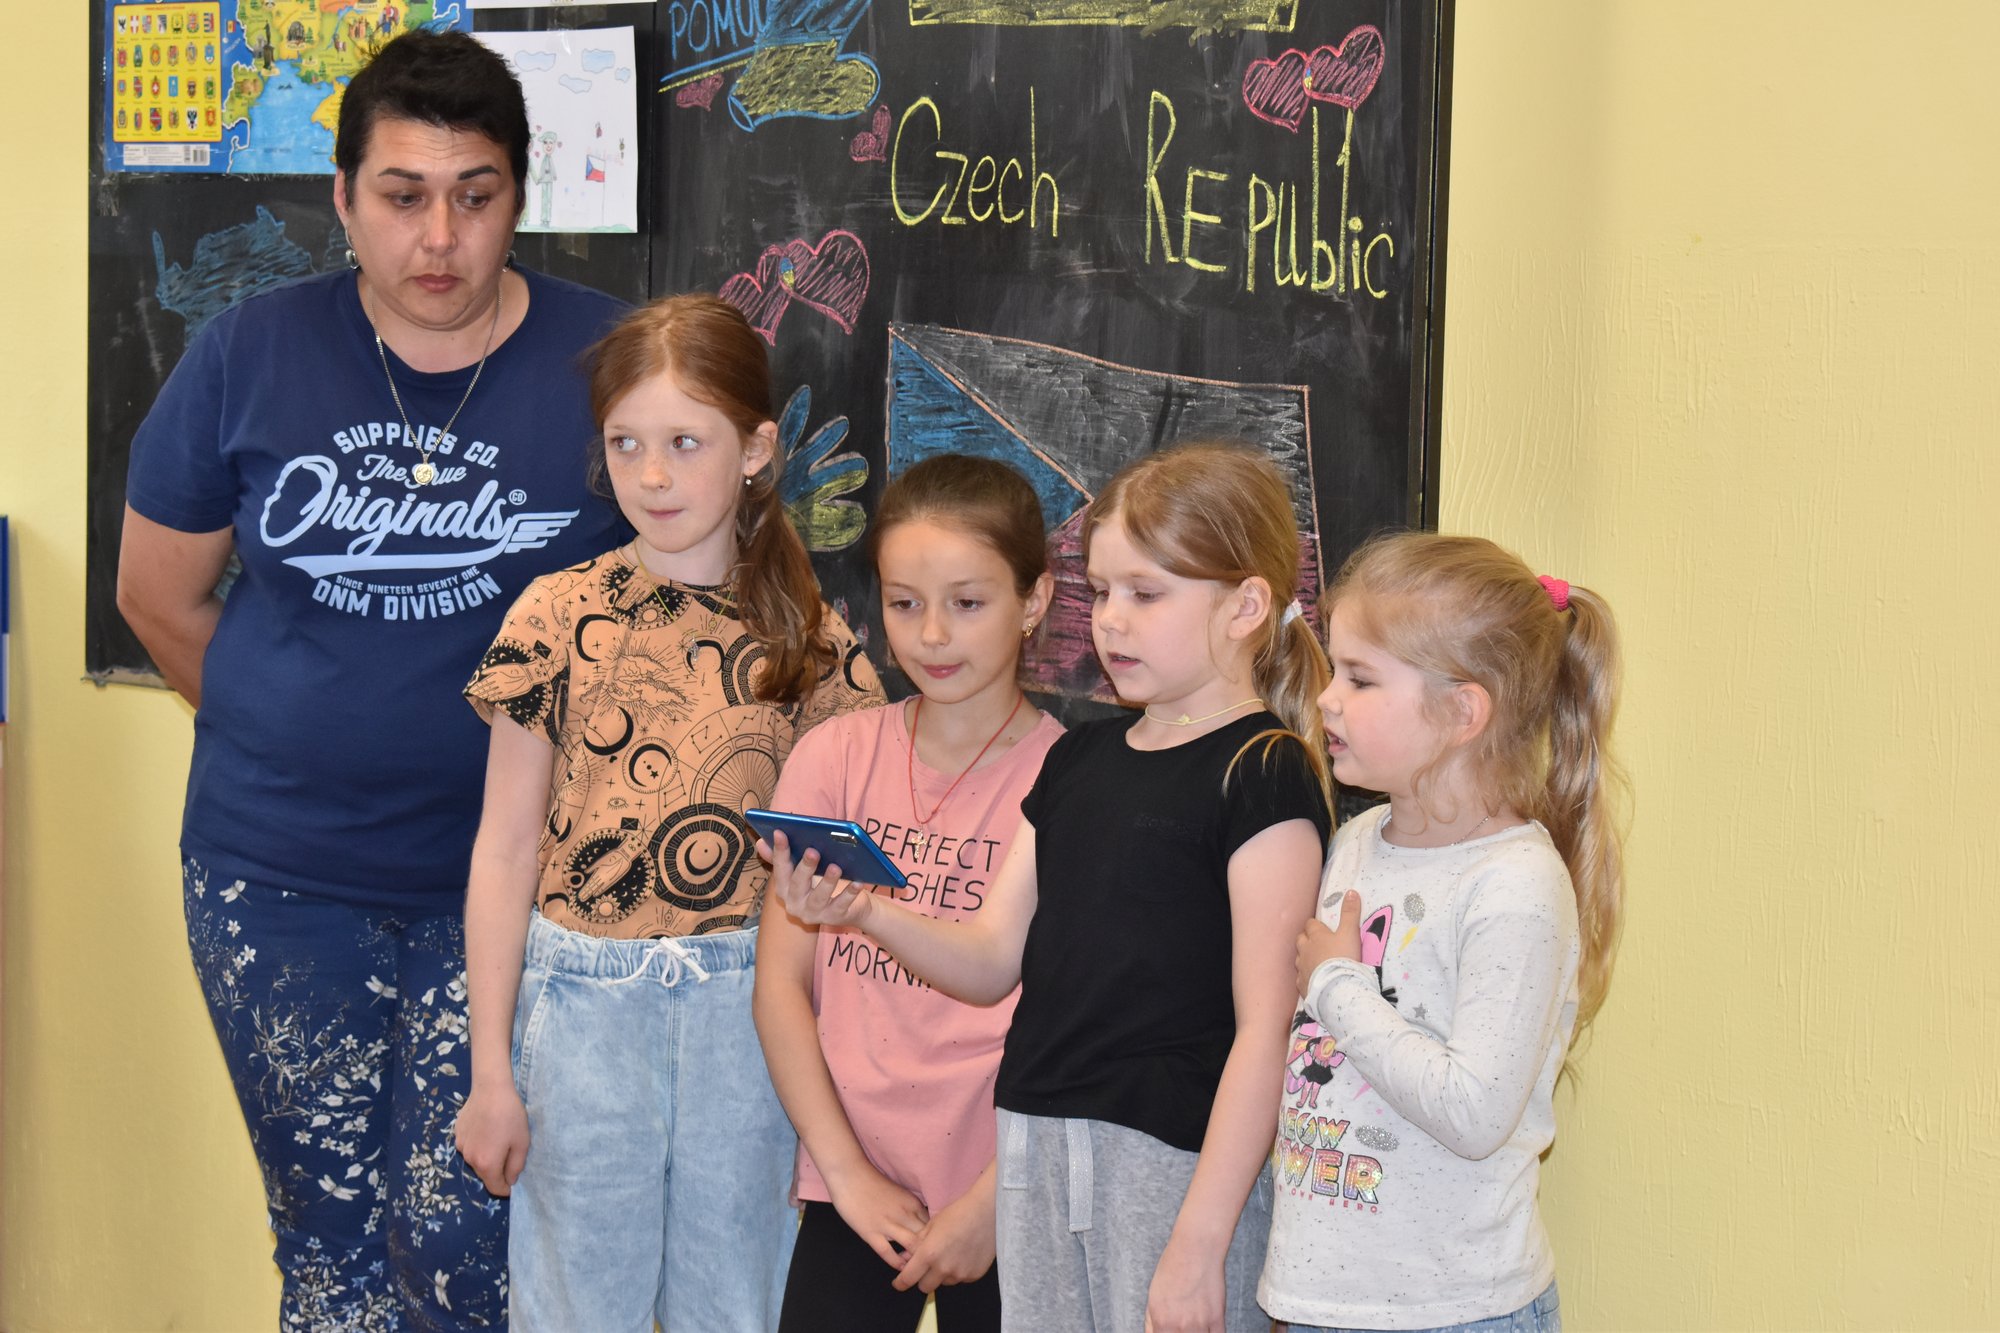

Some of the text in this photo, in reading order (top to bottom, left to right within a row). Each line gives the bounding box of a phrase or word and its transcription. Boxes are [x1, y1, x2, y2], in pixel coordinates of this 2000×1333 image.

[891, 86, 1059, 237] Czech
[333, 422, 499, 469] SUPPLIES CO.
[356, 454, 407, 481] The
[260, 454, 508, 557] Originals
[312, 573, 502, 621] DNM DIVISION
[335, 565, 480, 595] SINCE NINETEEN SEVENTY ONE
[865, 818, 1000, 872] PERFECT
